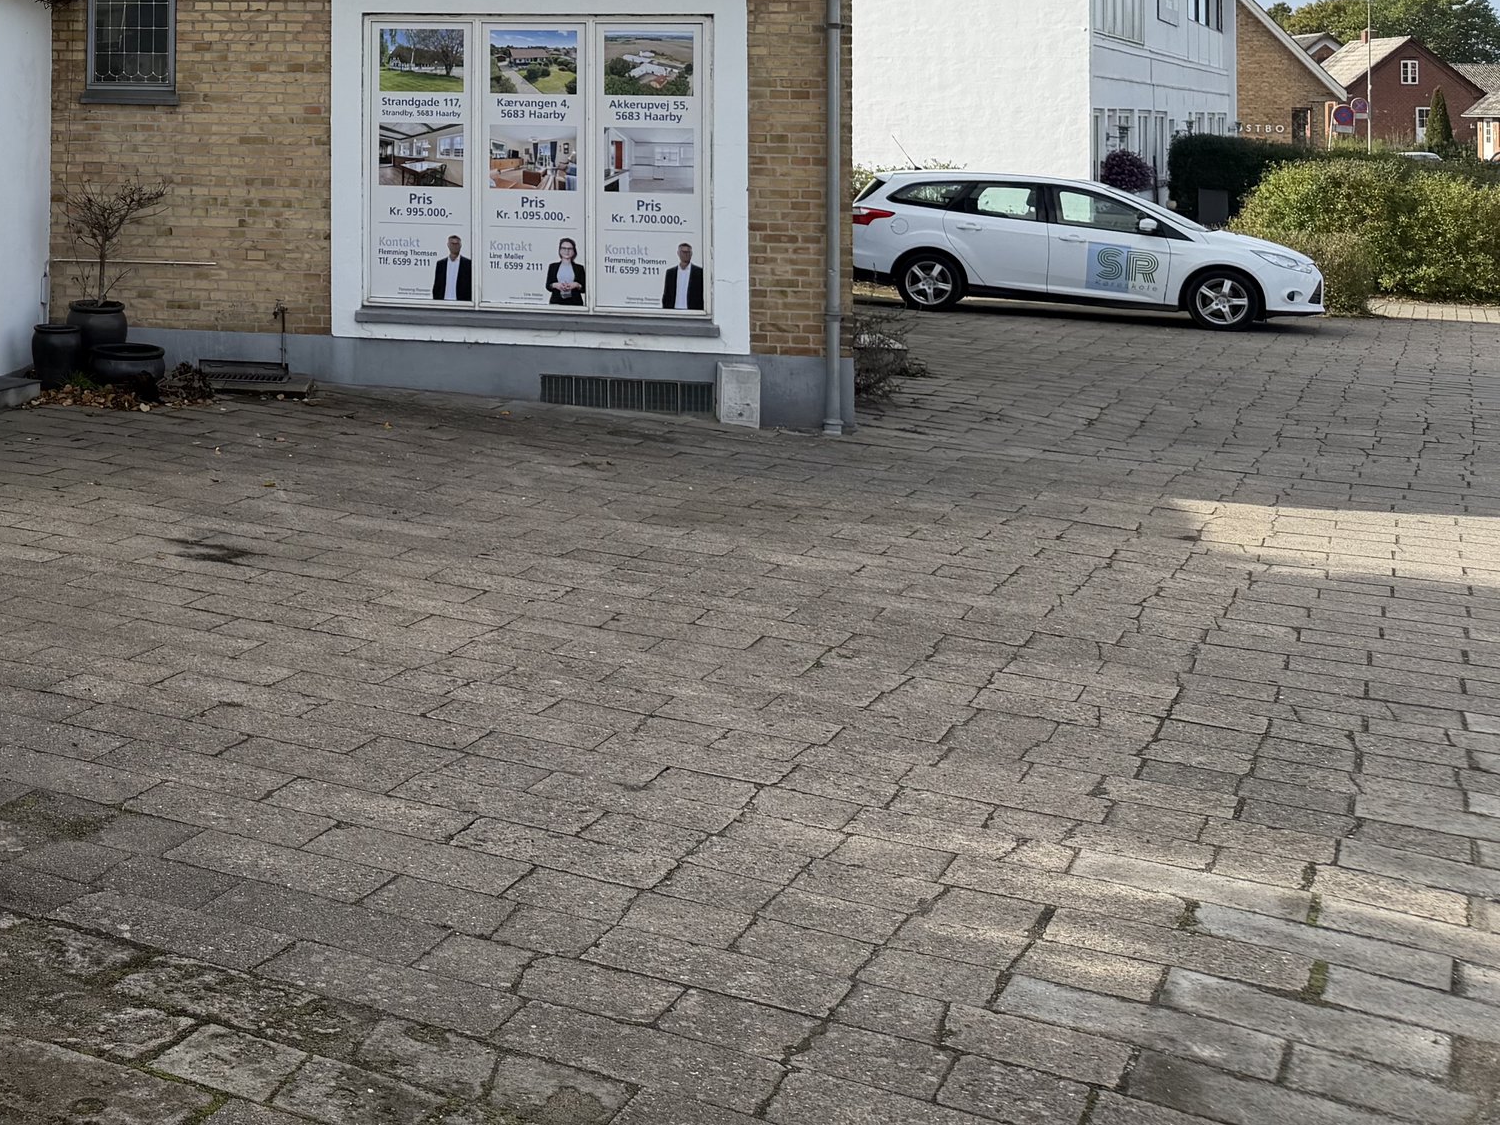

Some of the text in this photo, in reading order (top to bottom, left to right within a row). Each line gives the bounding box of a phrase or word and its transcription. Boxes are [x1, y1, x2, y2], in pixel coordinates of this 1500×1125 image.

[381, 96, 461, 108] Strandgade 117,
[496, 98, 570, 109] Kærvangen 4,
[608, 99, 689, 111] Akkerupvej 55,
[416, 109, 434, 117] 5683
[435, 110, 461, 119] Haarby
[500, 109, 566, 121] 5683 Haarby
[615, 111, 682, 123] 5683 Haarby
[409, 192, 433, 205] Pris
[521, 196, 545, 208] Pris
[636, 199, 662, 212] Pris
[389, 206, 453, 219] Kr. 995.000,-
[496, 210, 570, 222] Kr. 1.095.000,-
[611, 213, 688, 226] Kr. 1.700.000,-
[379, 236, 420, 248] Kontakt
[490, 240, 533, 252] Kontakt
[378, 248, 438, 257] Flemming Thomsen
[605, 243, 649, 256] Kontakt
[378, 256, 431, 266] Tlf. 6599 2111
[490, 261, 543, 271] Tlf. 6599 2111
[604, 256, 667, 265] Flemming Thomsen
[1095, 247, 1159, 284] SR
[604, 265, 660, 275] Tlf. 6599 2111
